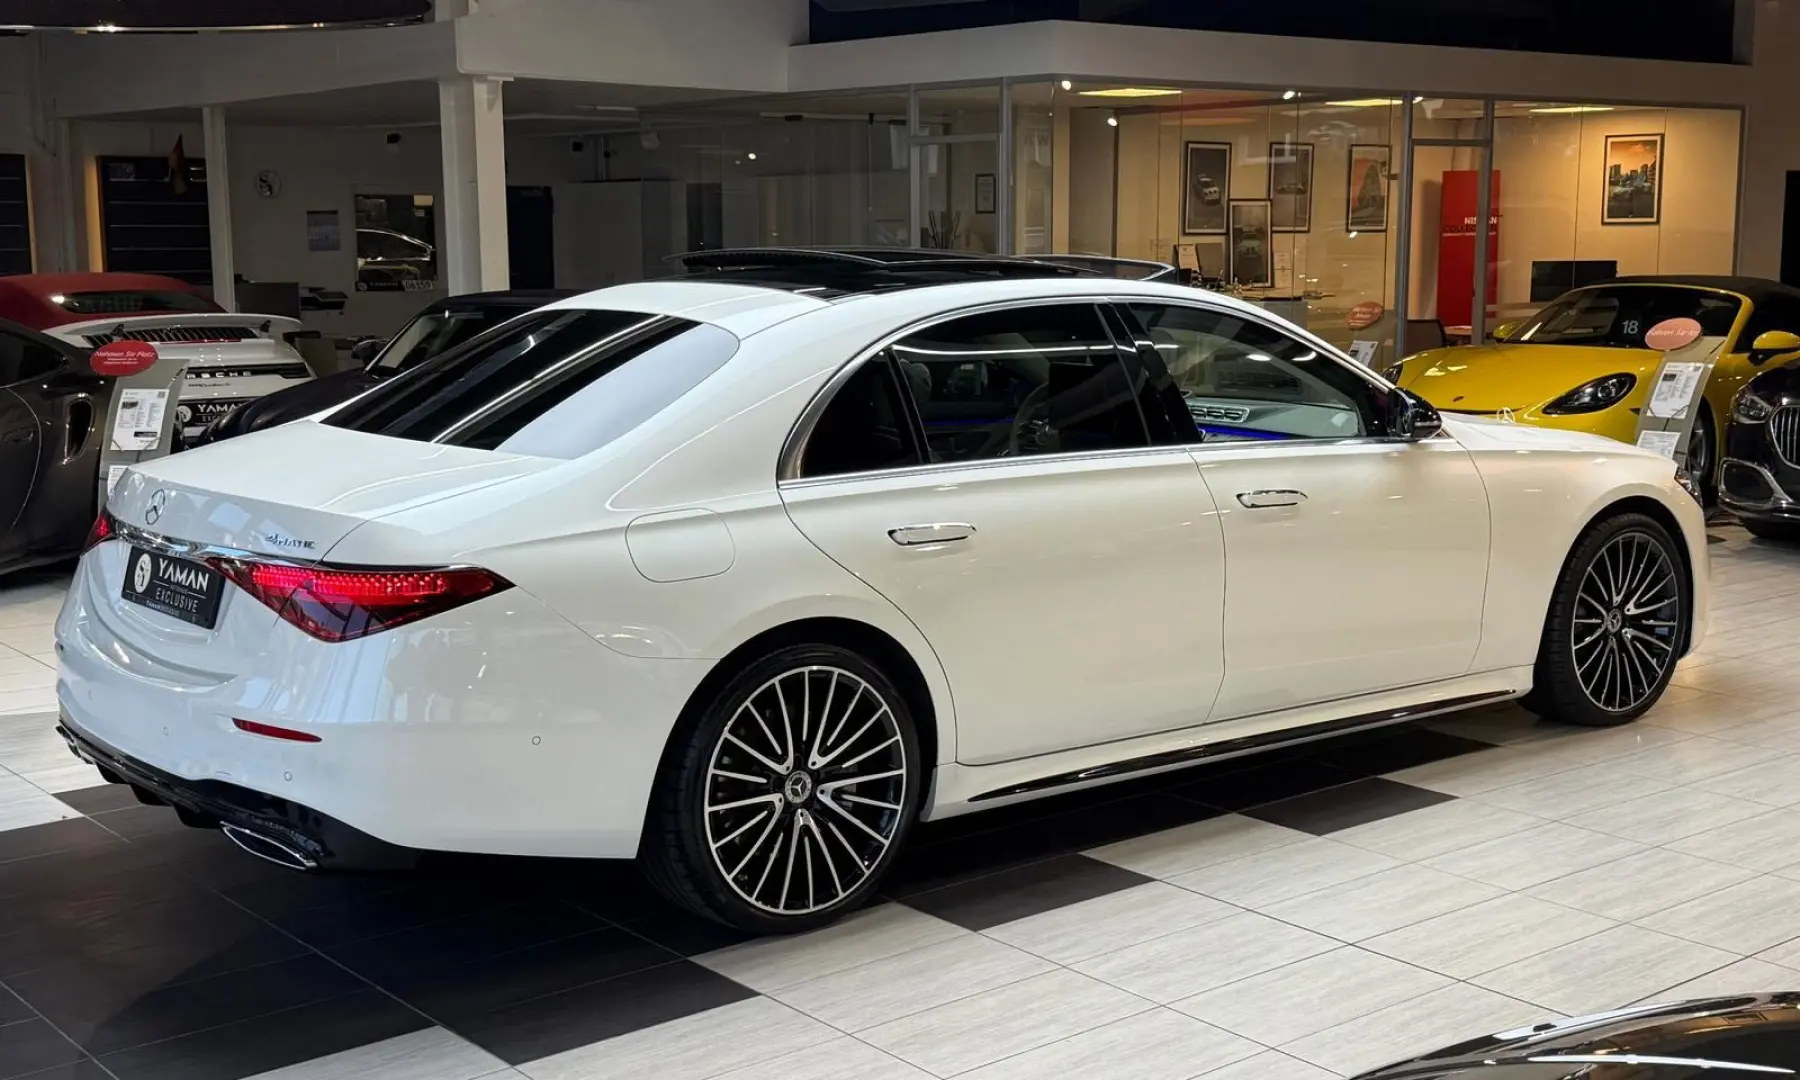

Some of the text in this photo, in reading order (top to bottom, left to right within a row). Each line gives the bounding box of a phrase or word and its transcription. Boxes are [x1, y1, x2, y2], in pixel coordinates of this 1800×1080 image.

[1464, 216, 1498, 225] NISN
[1622, 320, 1639, 334] 18
[197, 403, 237, 413] YAMA
[158, 557, 210, 592] YAMAN
[154, 587, 199, 613] EXCLUSIVE
